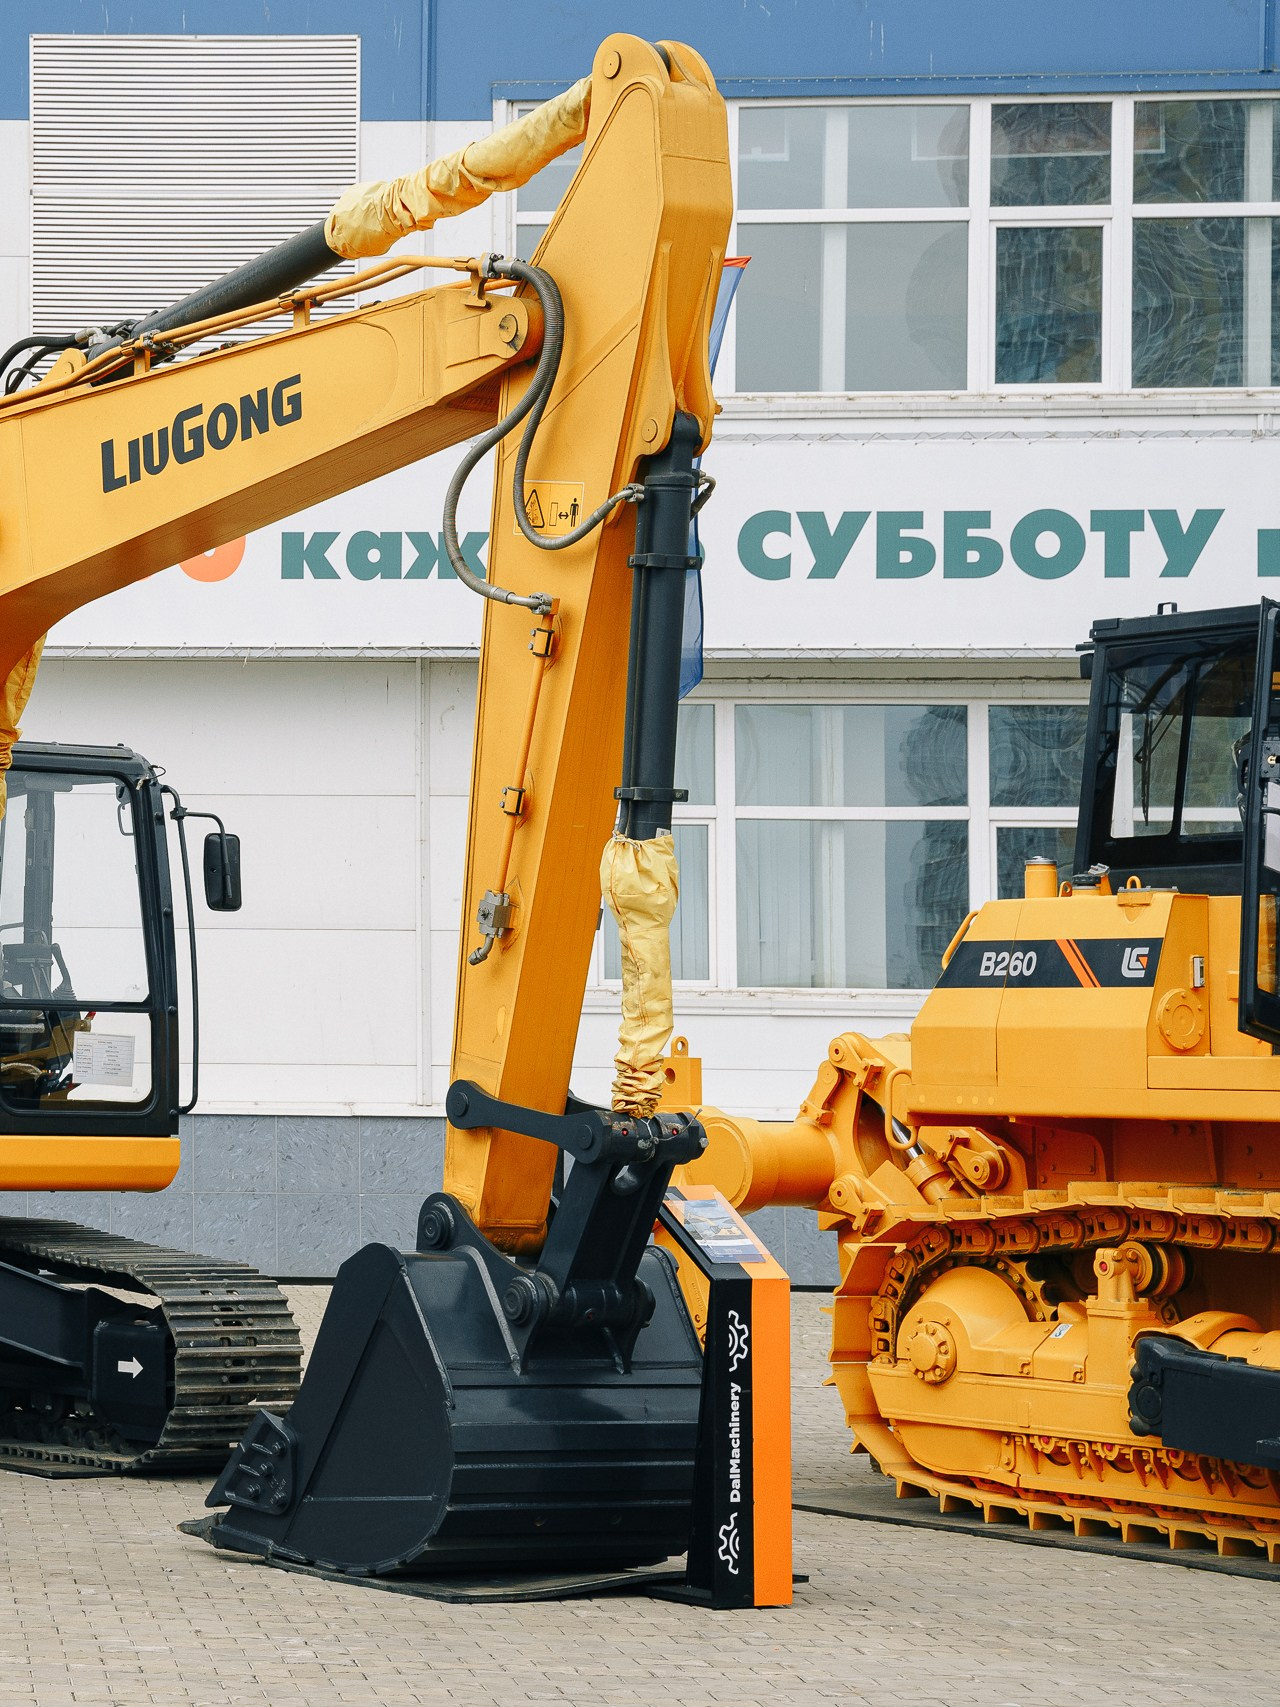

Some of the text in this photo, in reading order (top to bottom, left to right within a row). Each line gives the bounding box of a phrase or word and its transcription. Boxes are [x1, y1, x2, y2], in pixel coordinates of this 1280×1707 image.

[280, 530, 490, 581] каж
[737, 508, 1227, 581] СУББОТУ
[979, 951, 1037, 977] B260
[729, 1382, 742, 1503] DalMachinery
